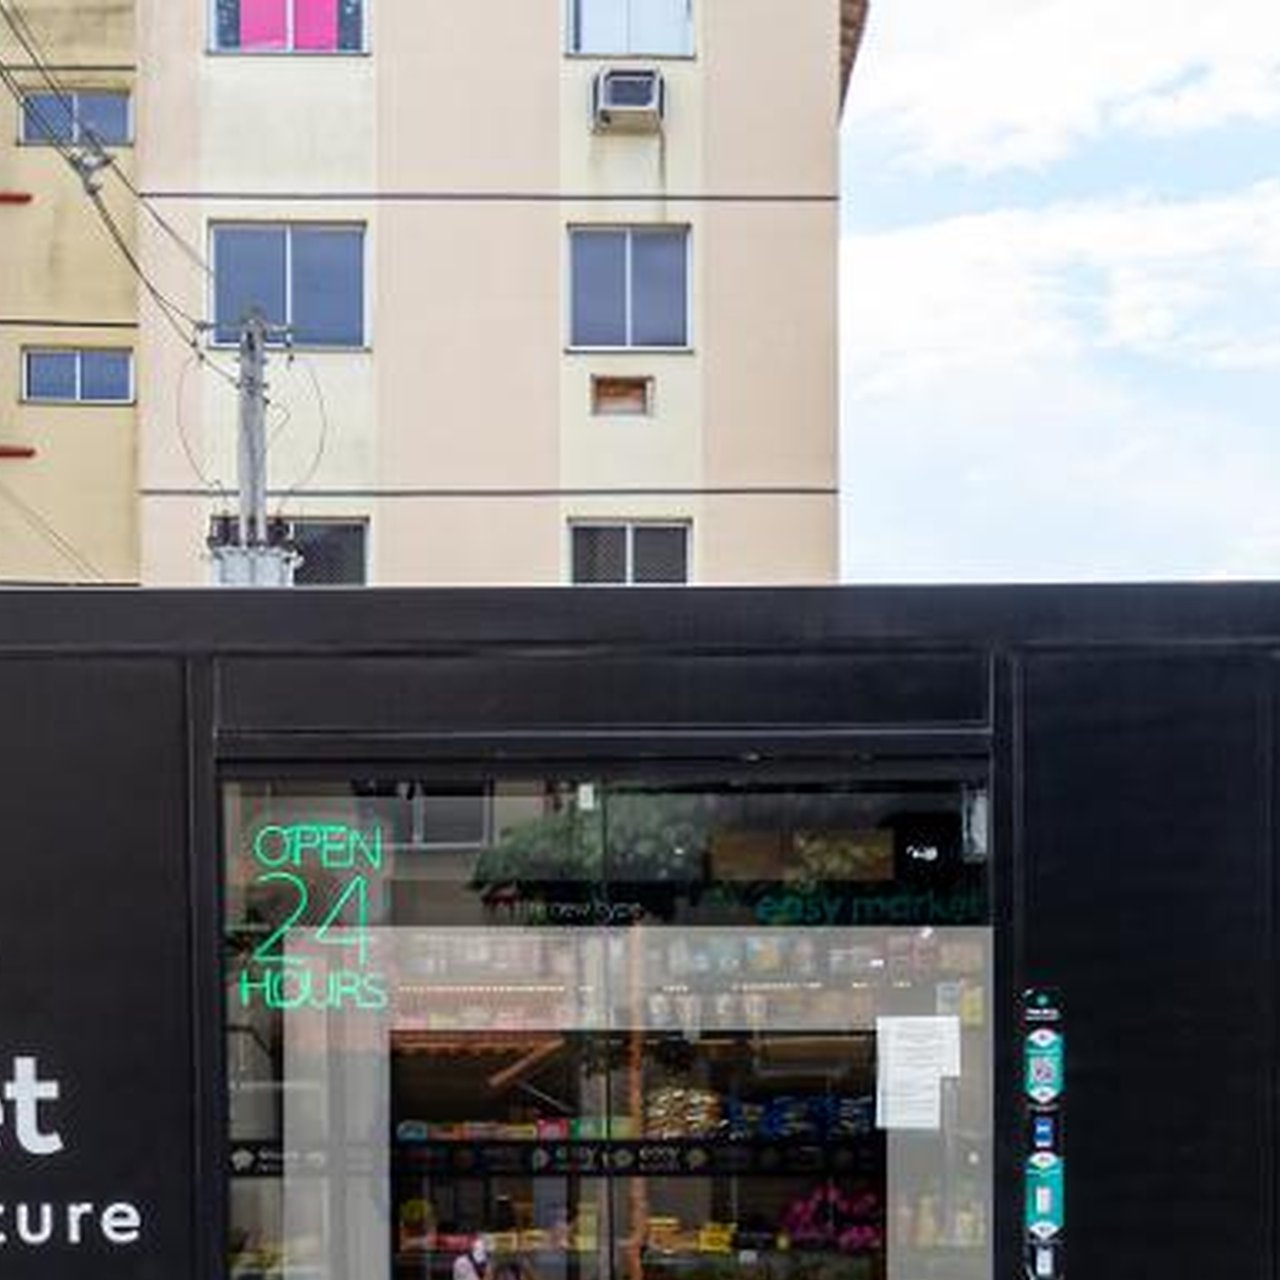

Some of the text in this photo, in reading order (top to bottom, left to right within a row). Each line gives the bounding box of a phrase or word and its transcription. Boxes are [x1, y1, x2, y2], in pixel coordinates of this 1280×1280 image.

[253, 821, 383, 868] OPEN
[251, 872, 372, 965] 24
[237, 969, 388, 1010] HOURS
